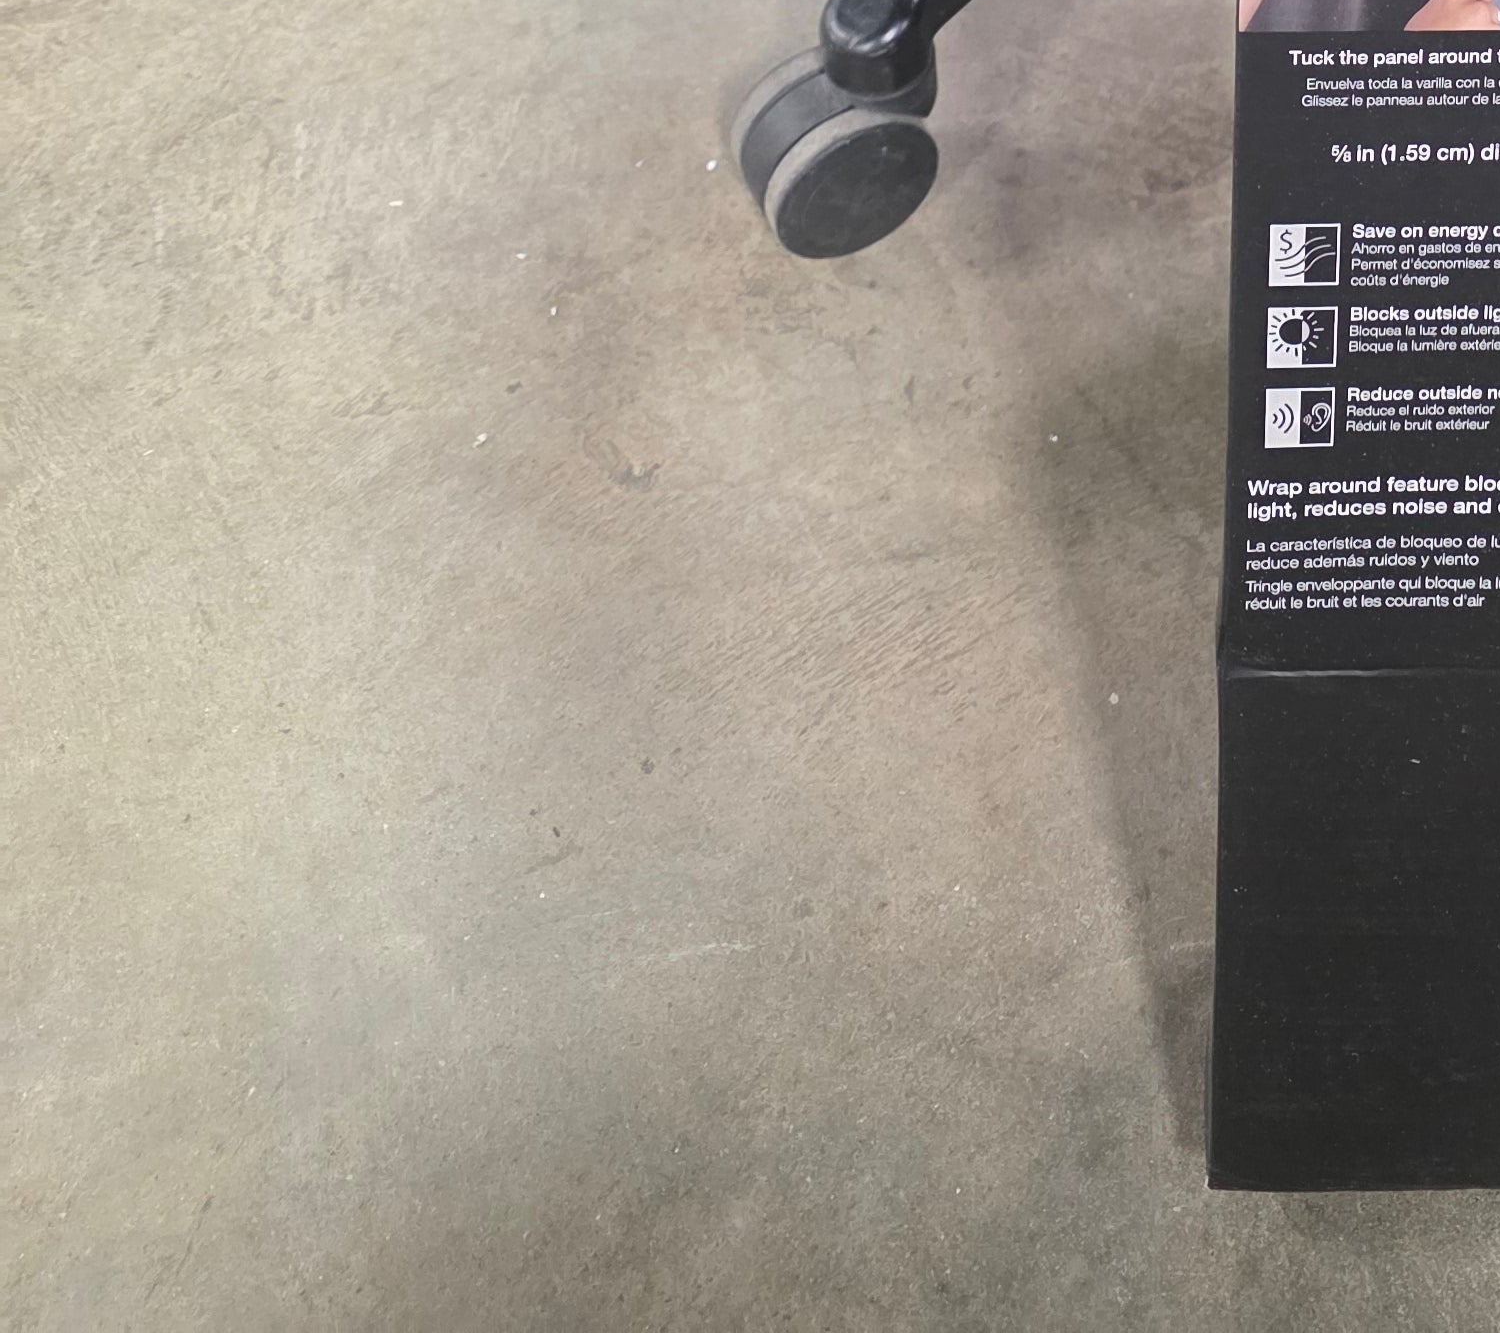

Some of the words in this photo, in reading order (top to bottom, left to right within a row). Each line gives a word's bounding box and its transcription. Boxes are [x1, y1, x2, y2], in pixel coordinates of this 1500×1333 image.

[1289, 50, 1334, 65] Tuck
[1339, 50, 1368, 64] the
[1374, 49, 1423, 67] panel
[1428, 48, 1492, 64] around
[1307, 78, 1364, 90] Envuelva
[1368, 78, 1398, 89] toda
[1402, 77, 1412, 89] la
[1416, 77, 1452, 88] varilla
[1456, 79, 1480, 88] con
[1484, 76, 1495, 88] la
[1302, 95, 1349, 107] Glissez
[1352, 94, 1363, 106] le
[1367, 96, 1423, 108] panneau
[1427, 94, 1469, 105] autour
[1472, 93, 1489, 104] de
[1357, 145, 1374, 162] in
[1381, 144, 1430, 165] (1.59
[1437, 143, 1474, 164] cm)
[1353, 224, 1396, 238] Save
[1401, 227, 1423, 238] on
[1429, 226, 1488, 240] energy
[1351, 243, 1395, 254] Ahorro
[1399, 245, 1414, 254] en
[1418, 242, 1461, 256] gastos
[1465, 242, 1481, 253] de
[1352, 258, 1397, 270] Permet
[1351, 274, 1386, 286] coûts
[1390, 274, 1449, 288] d'énergie
[1351, 306, 1409, 321] Blocks
[1414, 305, 1479, 320] outside
[1350, 325, 1401, 338] Bloquea
[1406, 325, 1416, 336] la
[1420, 325, 1437, 336] luz
[1441, 324, 1457, 335] de
[1461, 324, 1500, 335] afuera
[1349, 341, 1393, 353] Bloque
[1397, 340, 1407, 351] la
[1412, 339, 1457, 351] lumière
[1348, 387, 1413, 401] Reduce
[1419, 385, 1482, 400] outside
[1347, 405, 1395, 416] Reduce
[1399, 405, 1409, 415] el
[1413, 404, 1444, 415] ruido
[1448, 404, 1495, 415] exterior
[1346, 420, 1386, 431] Réduit
[1390, 420, 1401, 431] le
[1405, 419, 1432, 430] bruit
[1436, 419, 1490, 430] extérieur
[1248, 480, 1302, 498] Wrap
[1309, 477, 1380, 494] around
[1387, 477, 1459, 492] feature
[1248, 502, 1297, 522] light,
[1305, 500, 1386, 516] reduces
[1393, 498, 1447, 514] noise
[1453, 498, 1491, 514] and
[1247, 540, 1265, 552] La
[1270, 537, 1371, 552] característica
[1376, 536, 1396, 548] de
[1401, 535, 1462, 550] bloqueo
[1467, 535, 1486, 548] de
[1246, 557, 1299, 570] reduce
[1304, 554, 1364, 568] además
[1370, 553, 1416, 566] ruidos
[1421, 556, 1429, 568] y
[1434, 553, 1479, 566] viento
[1245, 580, 1292, 595] Tringle
[1297, 578, 1395, 593] enveloppante
[1399, 576, 1421, 592] qui
[1425, 576, 1475, 591] bloque
[1479, 576, 1491, 589] la
[1246, 597, 1286, 610] réduit
[1291, 597, 1303, 609] le
[1307, 596, 1339, 608] bruit
[1343, 596, 1357, 607] et
[1361, 595, 1381, 607] les
[1385, 595, 1449, 607] courants
[1453, 594, 1485, 607] d'air
